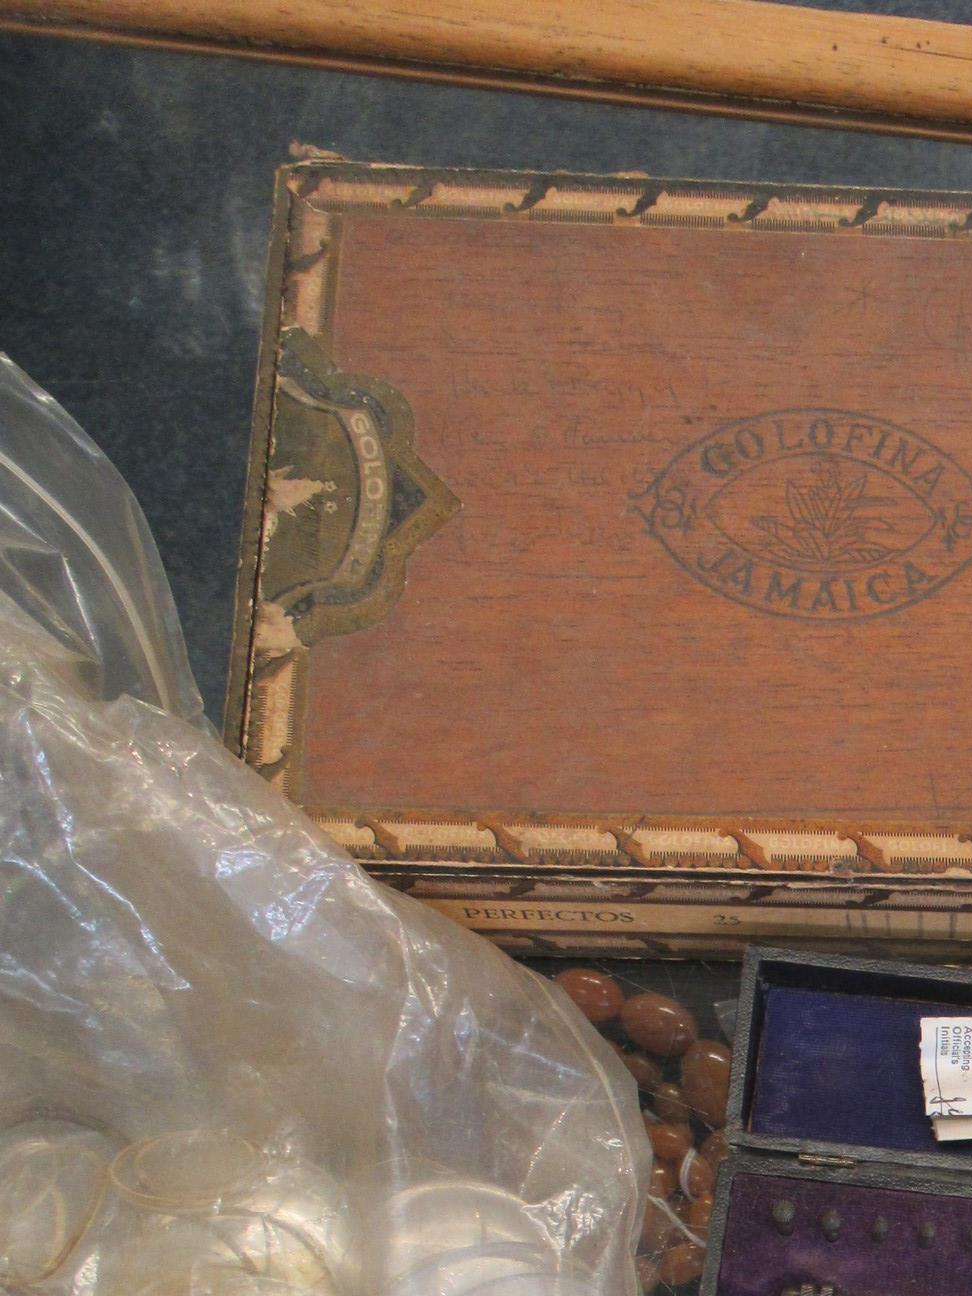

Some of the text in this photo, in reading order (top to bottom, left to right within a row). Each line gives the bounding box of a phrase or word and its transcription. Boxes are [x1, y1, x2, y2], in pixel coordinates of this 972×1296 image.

[701, 417, 947, 497] GOLOFINA
[697, 548, 939, 612] JAMAICA
[463, 906, 741, 927] PERFECTOS 25
[939, 1026, 950, 1057] Initials
[950, 1026, 962, 1065] Official's
[960, 1026, 972, 1072] Accepting
